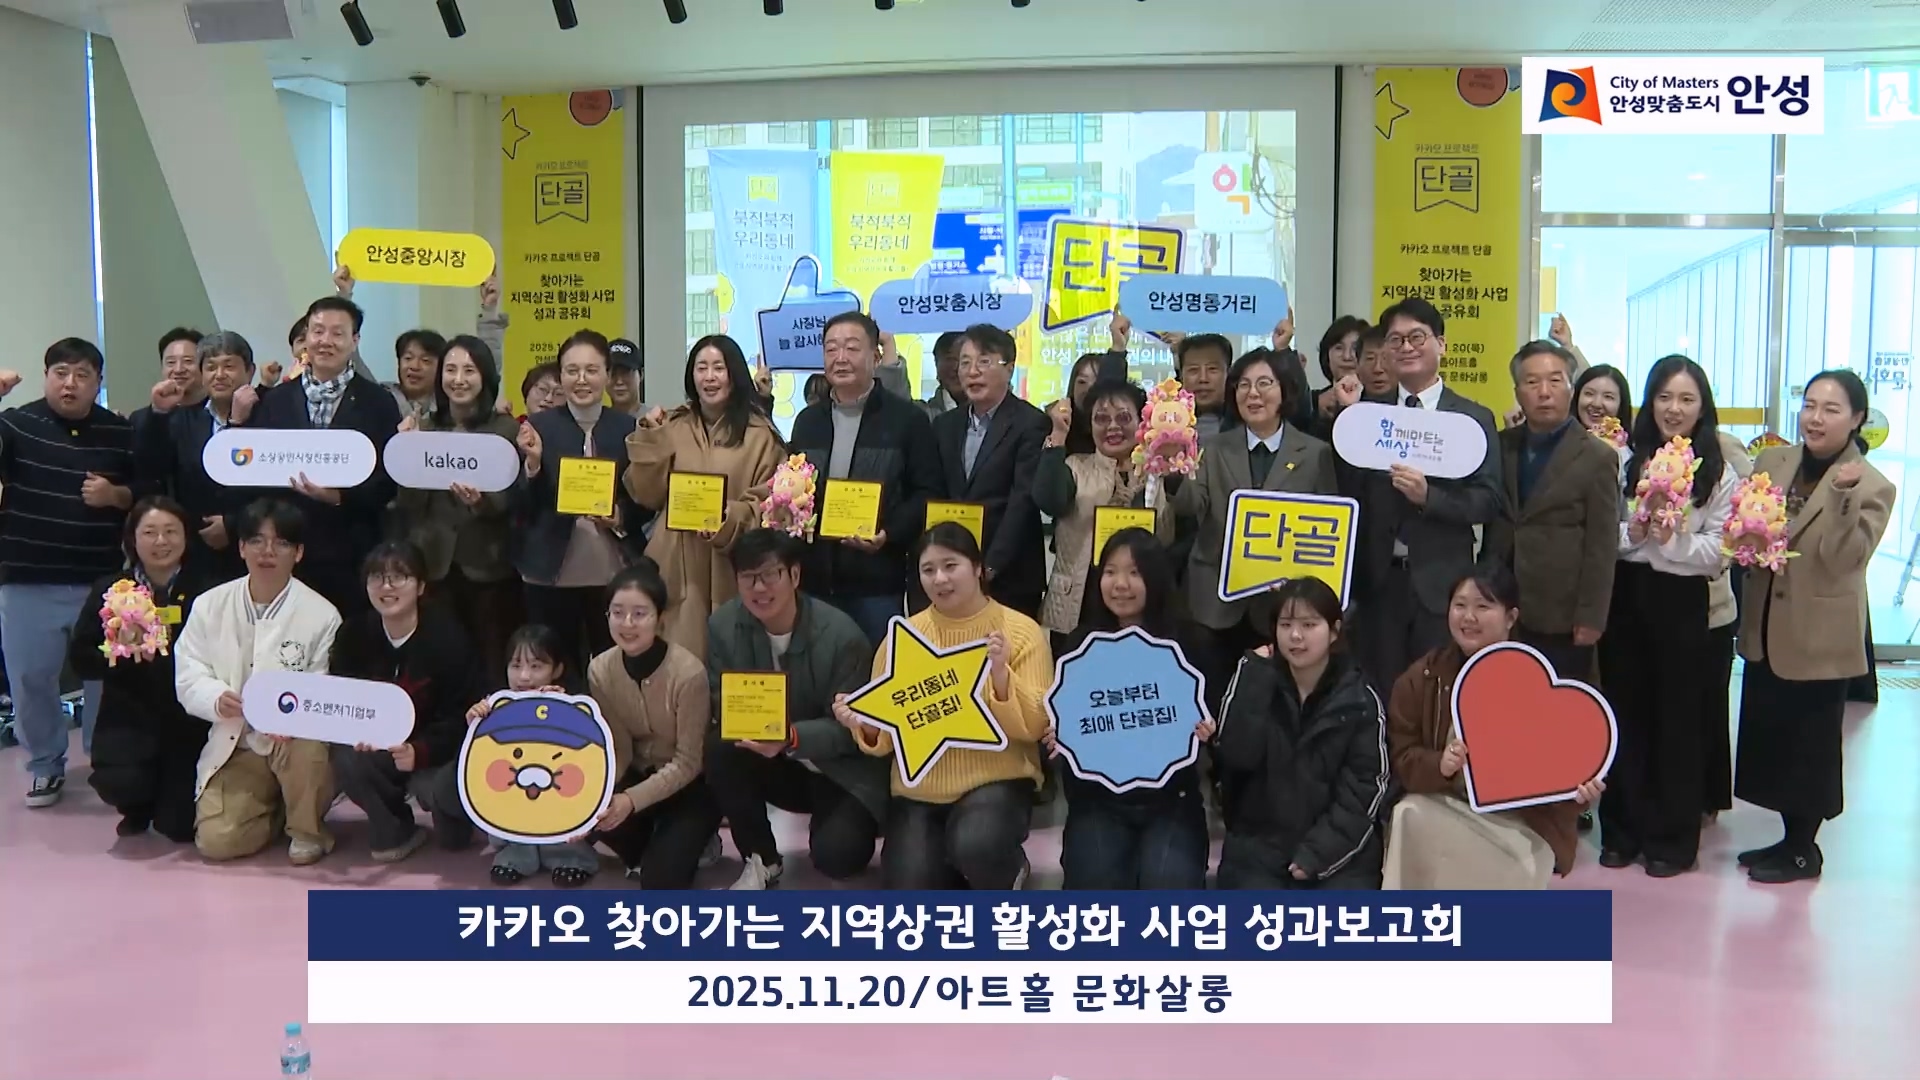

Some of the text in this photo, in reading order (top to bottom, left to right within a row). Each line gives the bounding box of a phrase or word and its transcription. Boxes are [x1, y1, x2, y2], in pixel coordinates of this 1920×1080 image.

[1421, 165, 1474, 192] 단골
[541, 180, 584, 206] 단골
[733, 231, 795, 250] 우리동네
[849, 234, 910, 252] 우리동네
[1400, 244, 1429, 256] 카카오
[1432, 245, 1470, 256] 프로젝트
[366, 245, 466, 268] 안성중앙시장
[541, 274, 584, 288] 찾아가는
[1419, 267, 1472, 282] 찾아가는
[511, 289, 615, 304] 지역상권 활성화 사업
[898, 293, 1002, 315] 안성맞춤시장
[1148, 290, 1257, 314] 안성명동거리
[1382, 286, 1508, 302] 지역상권 활성화 사업
[534, 306, 591, 321] 성과 공유회
[1041, 347, 1072, 366] 안성
[1375, 439, 1410, 459] 세상
[424, 451, 479, 471] kakao
[1243, 511, 1341, 567] 단골
[891, 667, 960, 708] 우리동네
[1089, 681, 1160, 708] 오늘부터
[303, 699, 376, 720] 중소벤처기업부
[906, 693, 963, 730] 단골집!
[1080, 704, 1178, 735] 최애 단골집!
